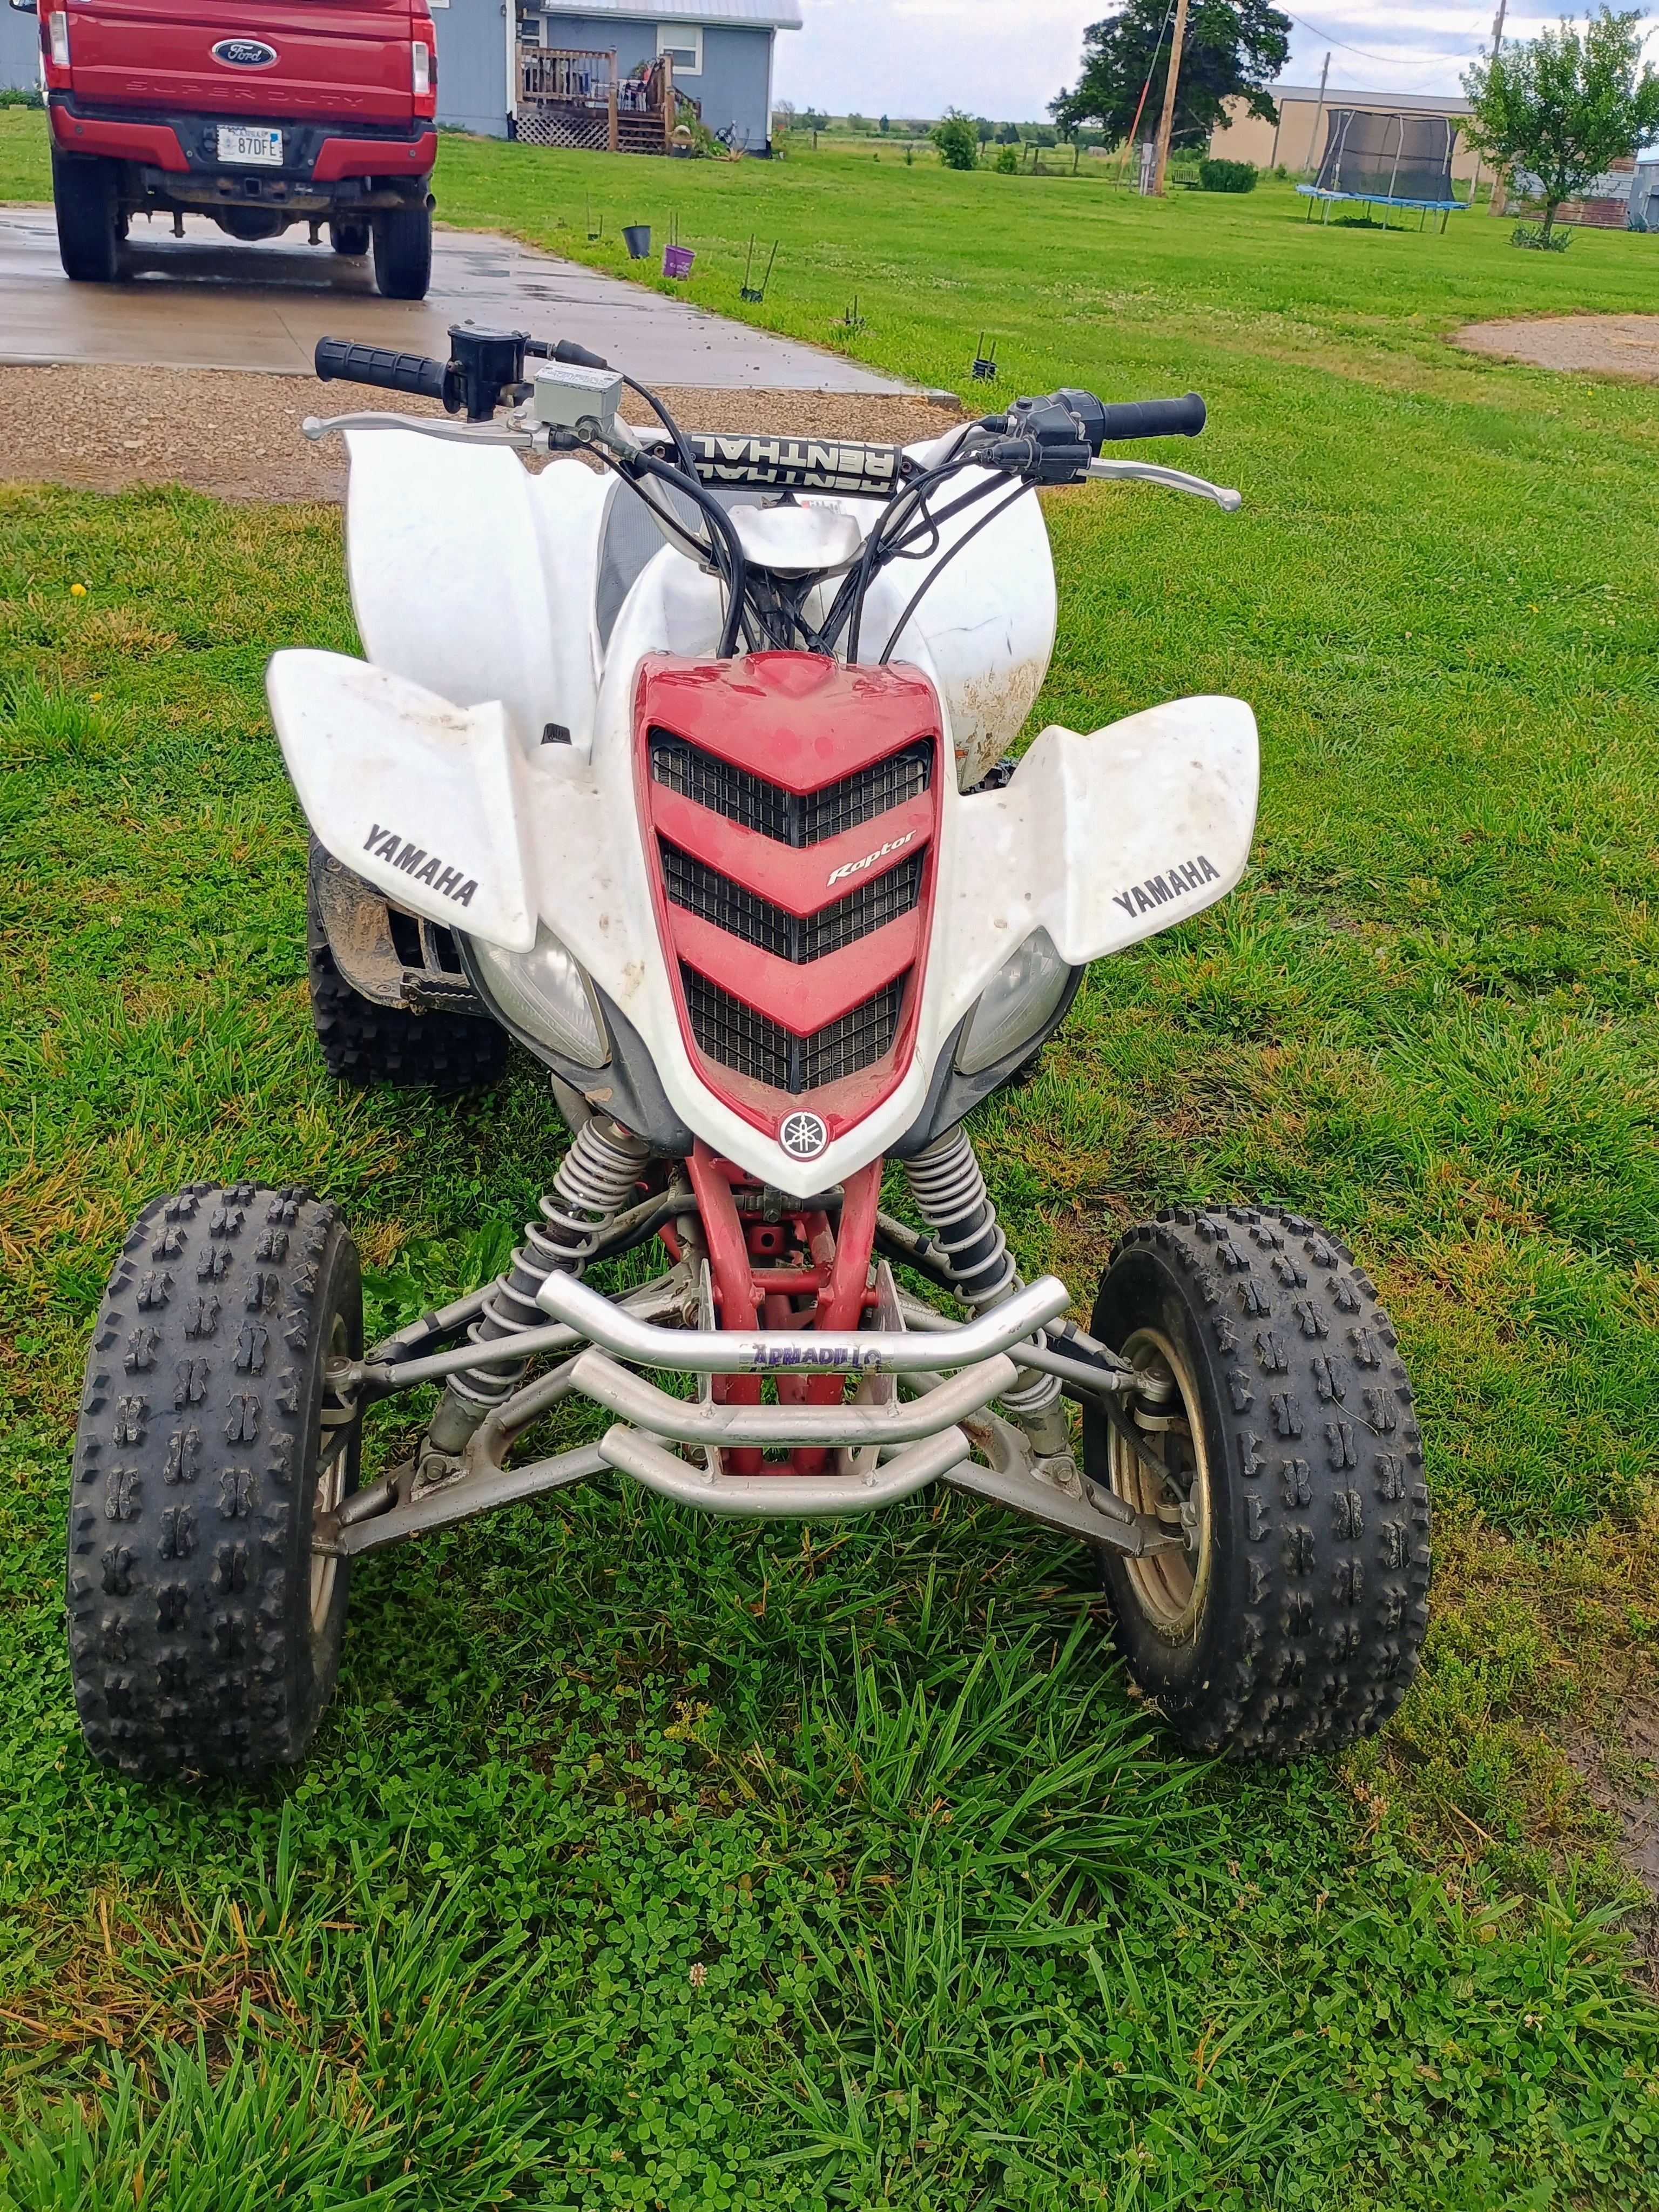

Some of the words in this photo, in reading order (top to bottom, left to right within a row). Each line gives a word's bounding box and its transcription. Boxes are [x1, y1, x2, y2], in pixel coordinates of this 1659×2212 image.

[227, 44, 262, 62] Ford
[126, 81, 257, 100] SUPER
[267, 91, 363, 107] DUTY
[691, 435, 894, 478] RENTHAL
[363, 824, 479, 907] YAMAHA
[826, 830, 917, 887] Raptor
[1111, 855, 1220, 918] YAMAHA
